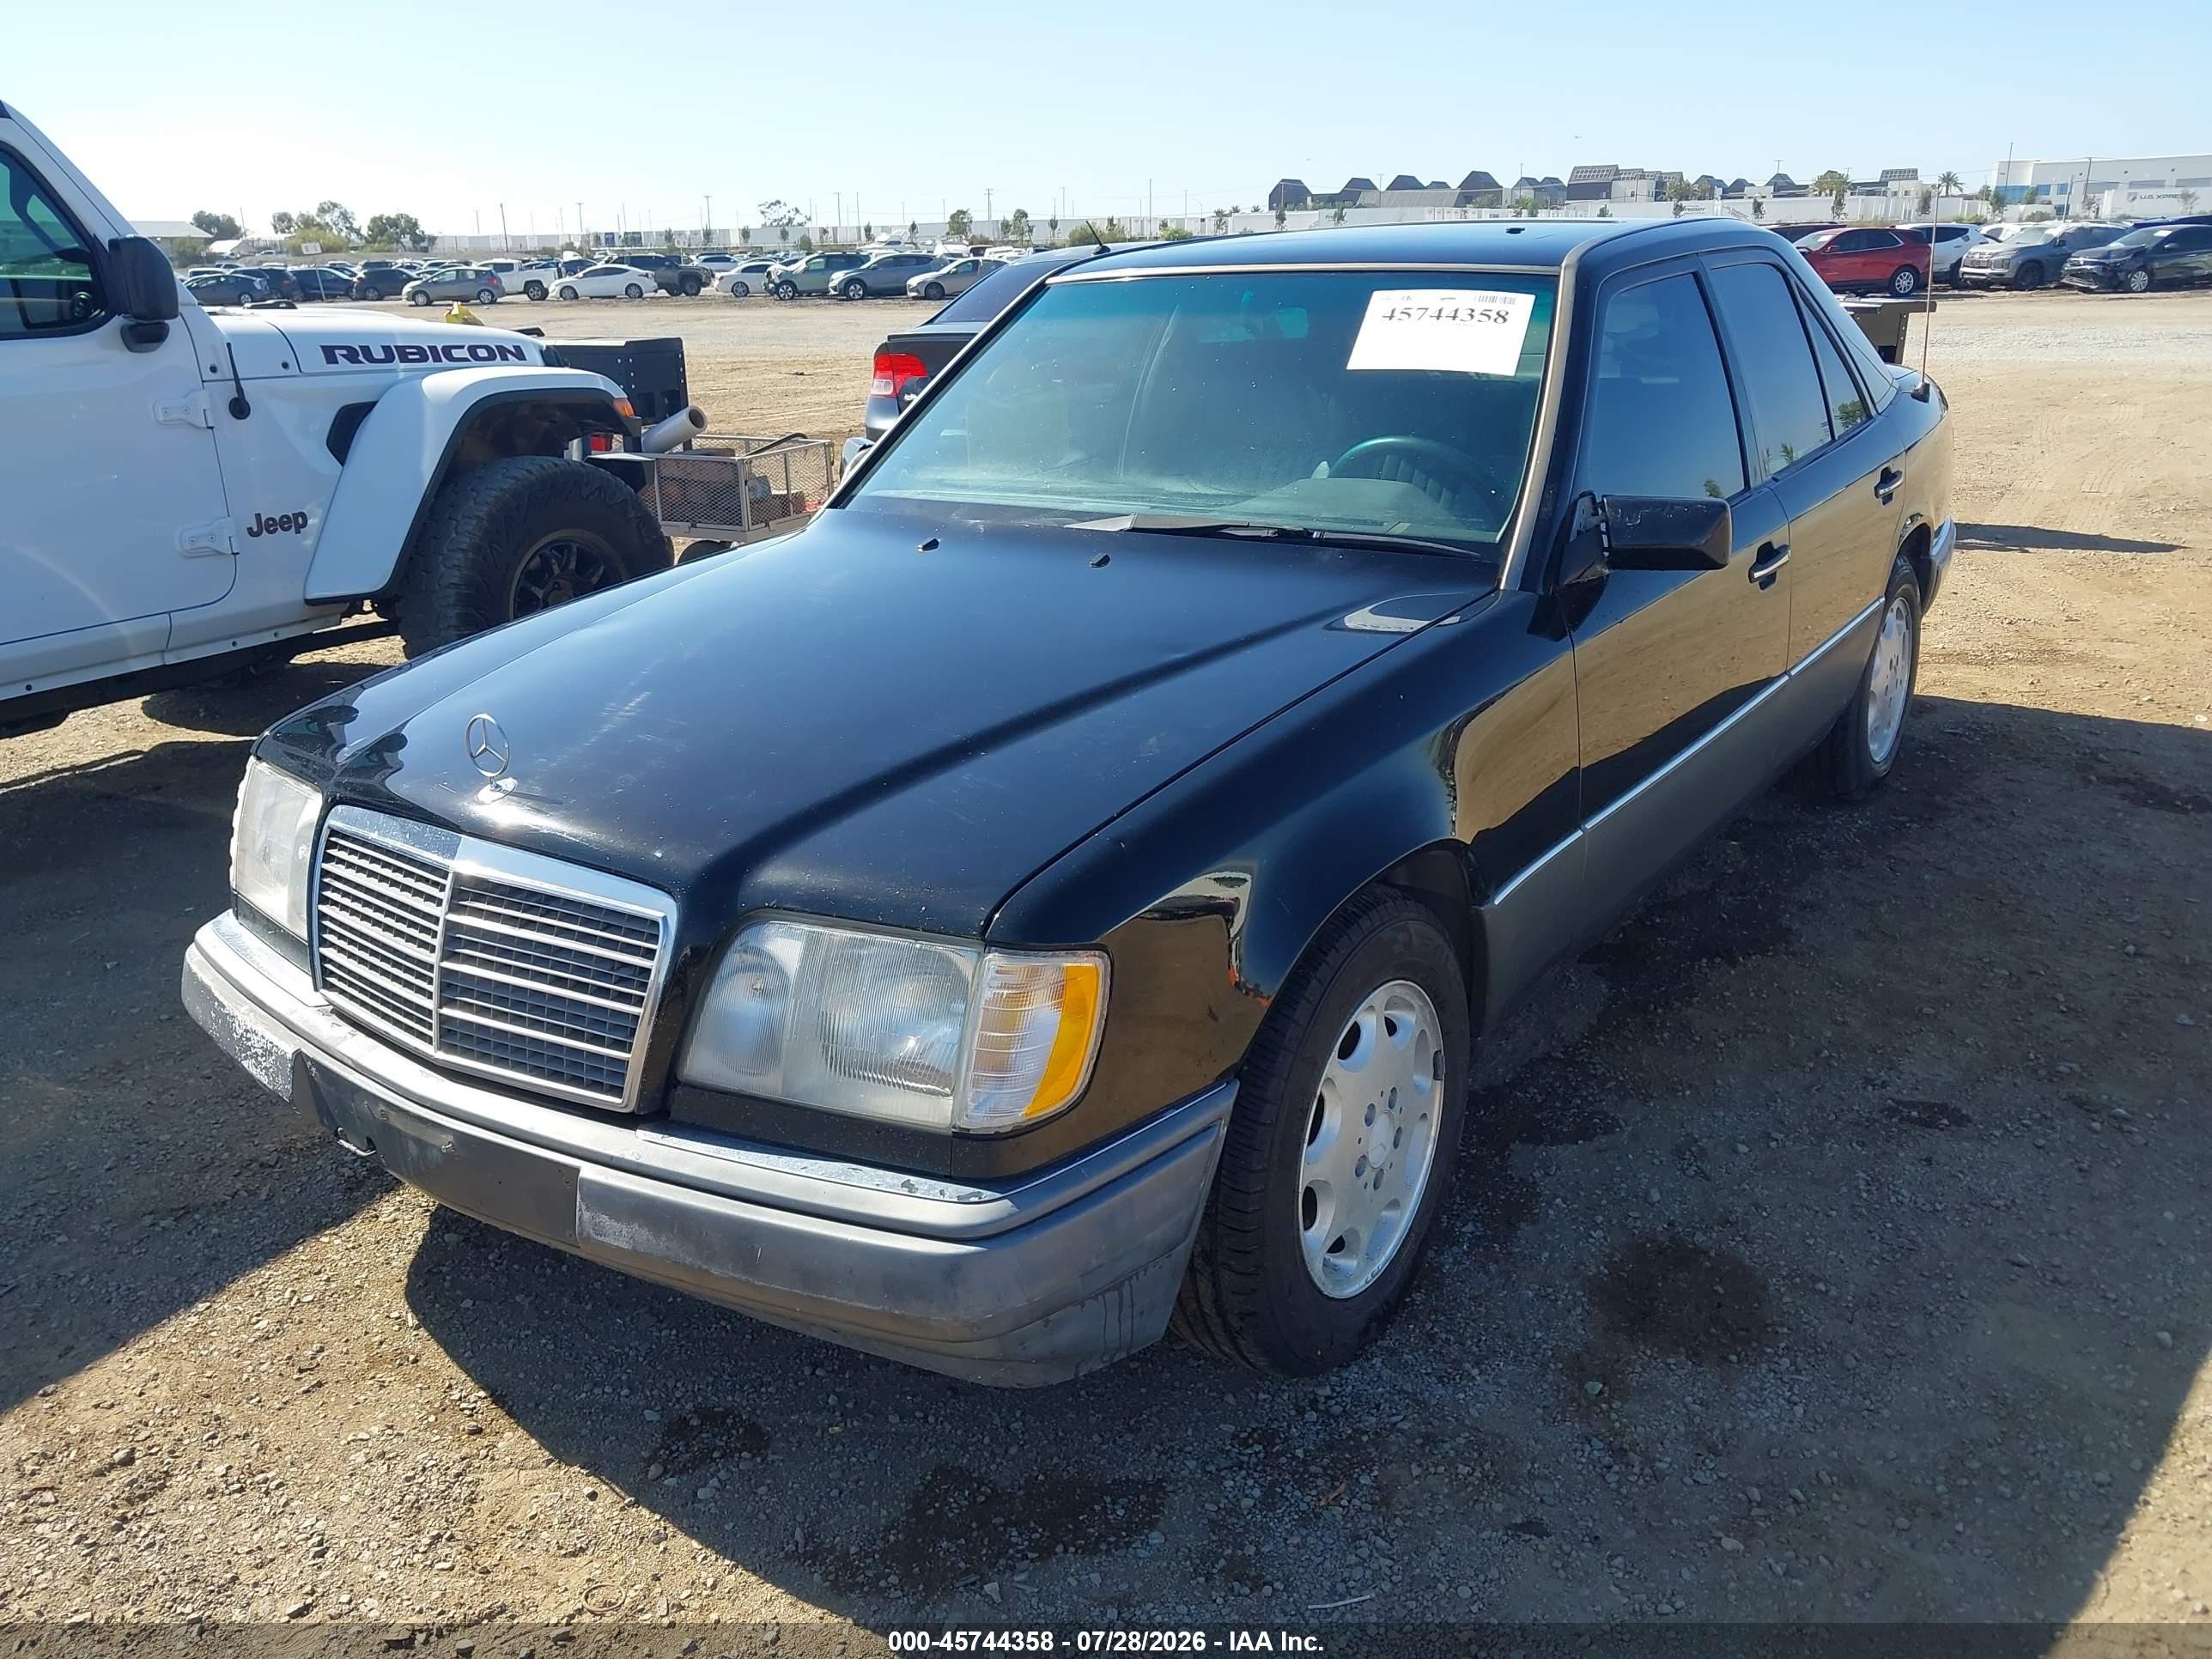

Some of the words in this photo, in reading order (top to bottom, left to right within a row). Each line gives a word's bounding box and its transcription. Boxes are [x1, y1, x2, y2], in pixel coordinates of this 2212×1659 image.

[1382, 307, 1510, 325] 45744358
[319, 343, 528, 365] RUBICON
[246, 511, 308, 538] Jeep
